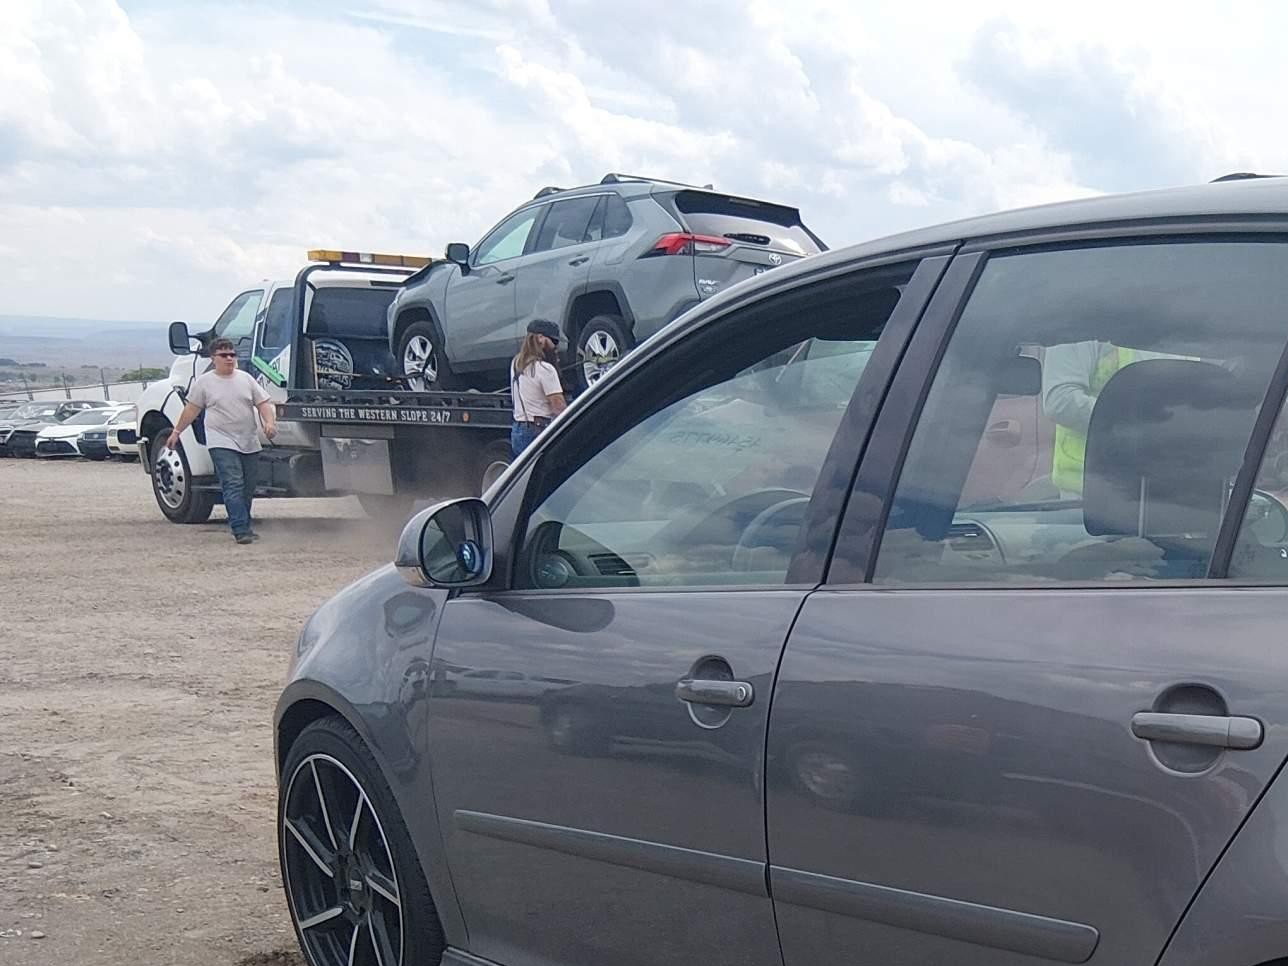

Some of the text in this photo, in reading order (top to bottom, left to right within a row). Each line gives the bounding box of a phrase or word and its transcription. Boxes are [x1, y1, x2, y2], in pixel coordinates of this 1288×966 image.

[301, 407, 451, 424] SERVING THE WESTERN SLOPE 24/7
